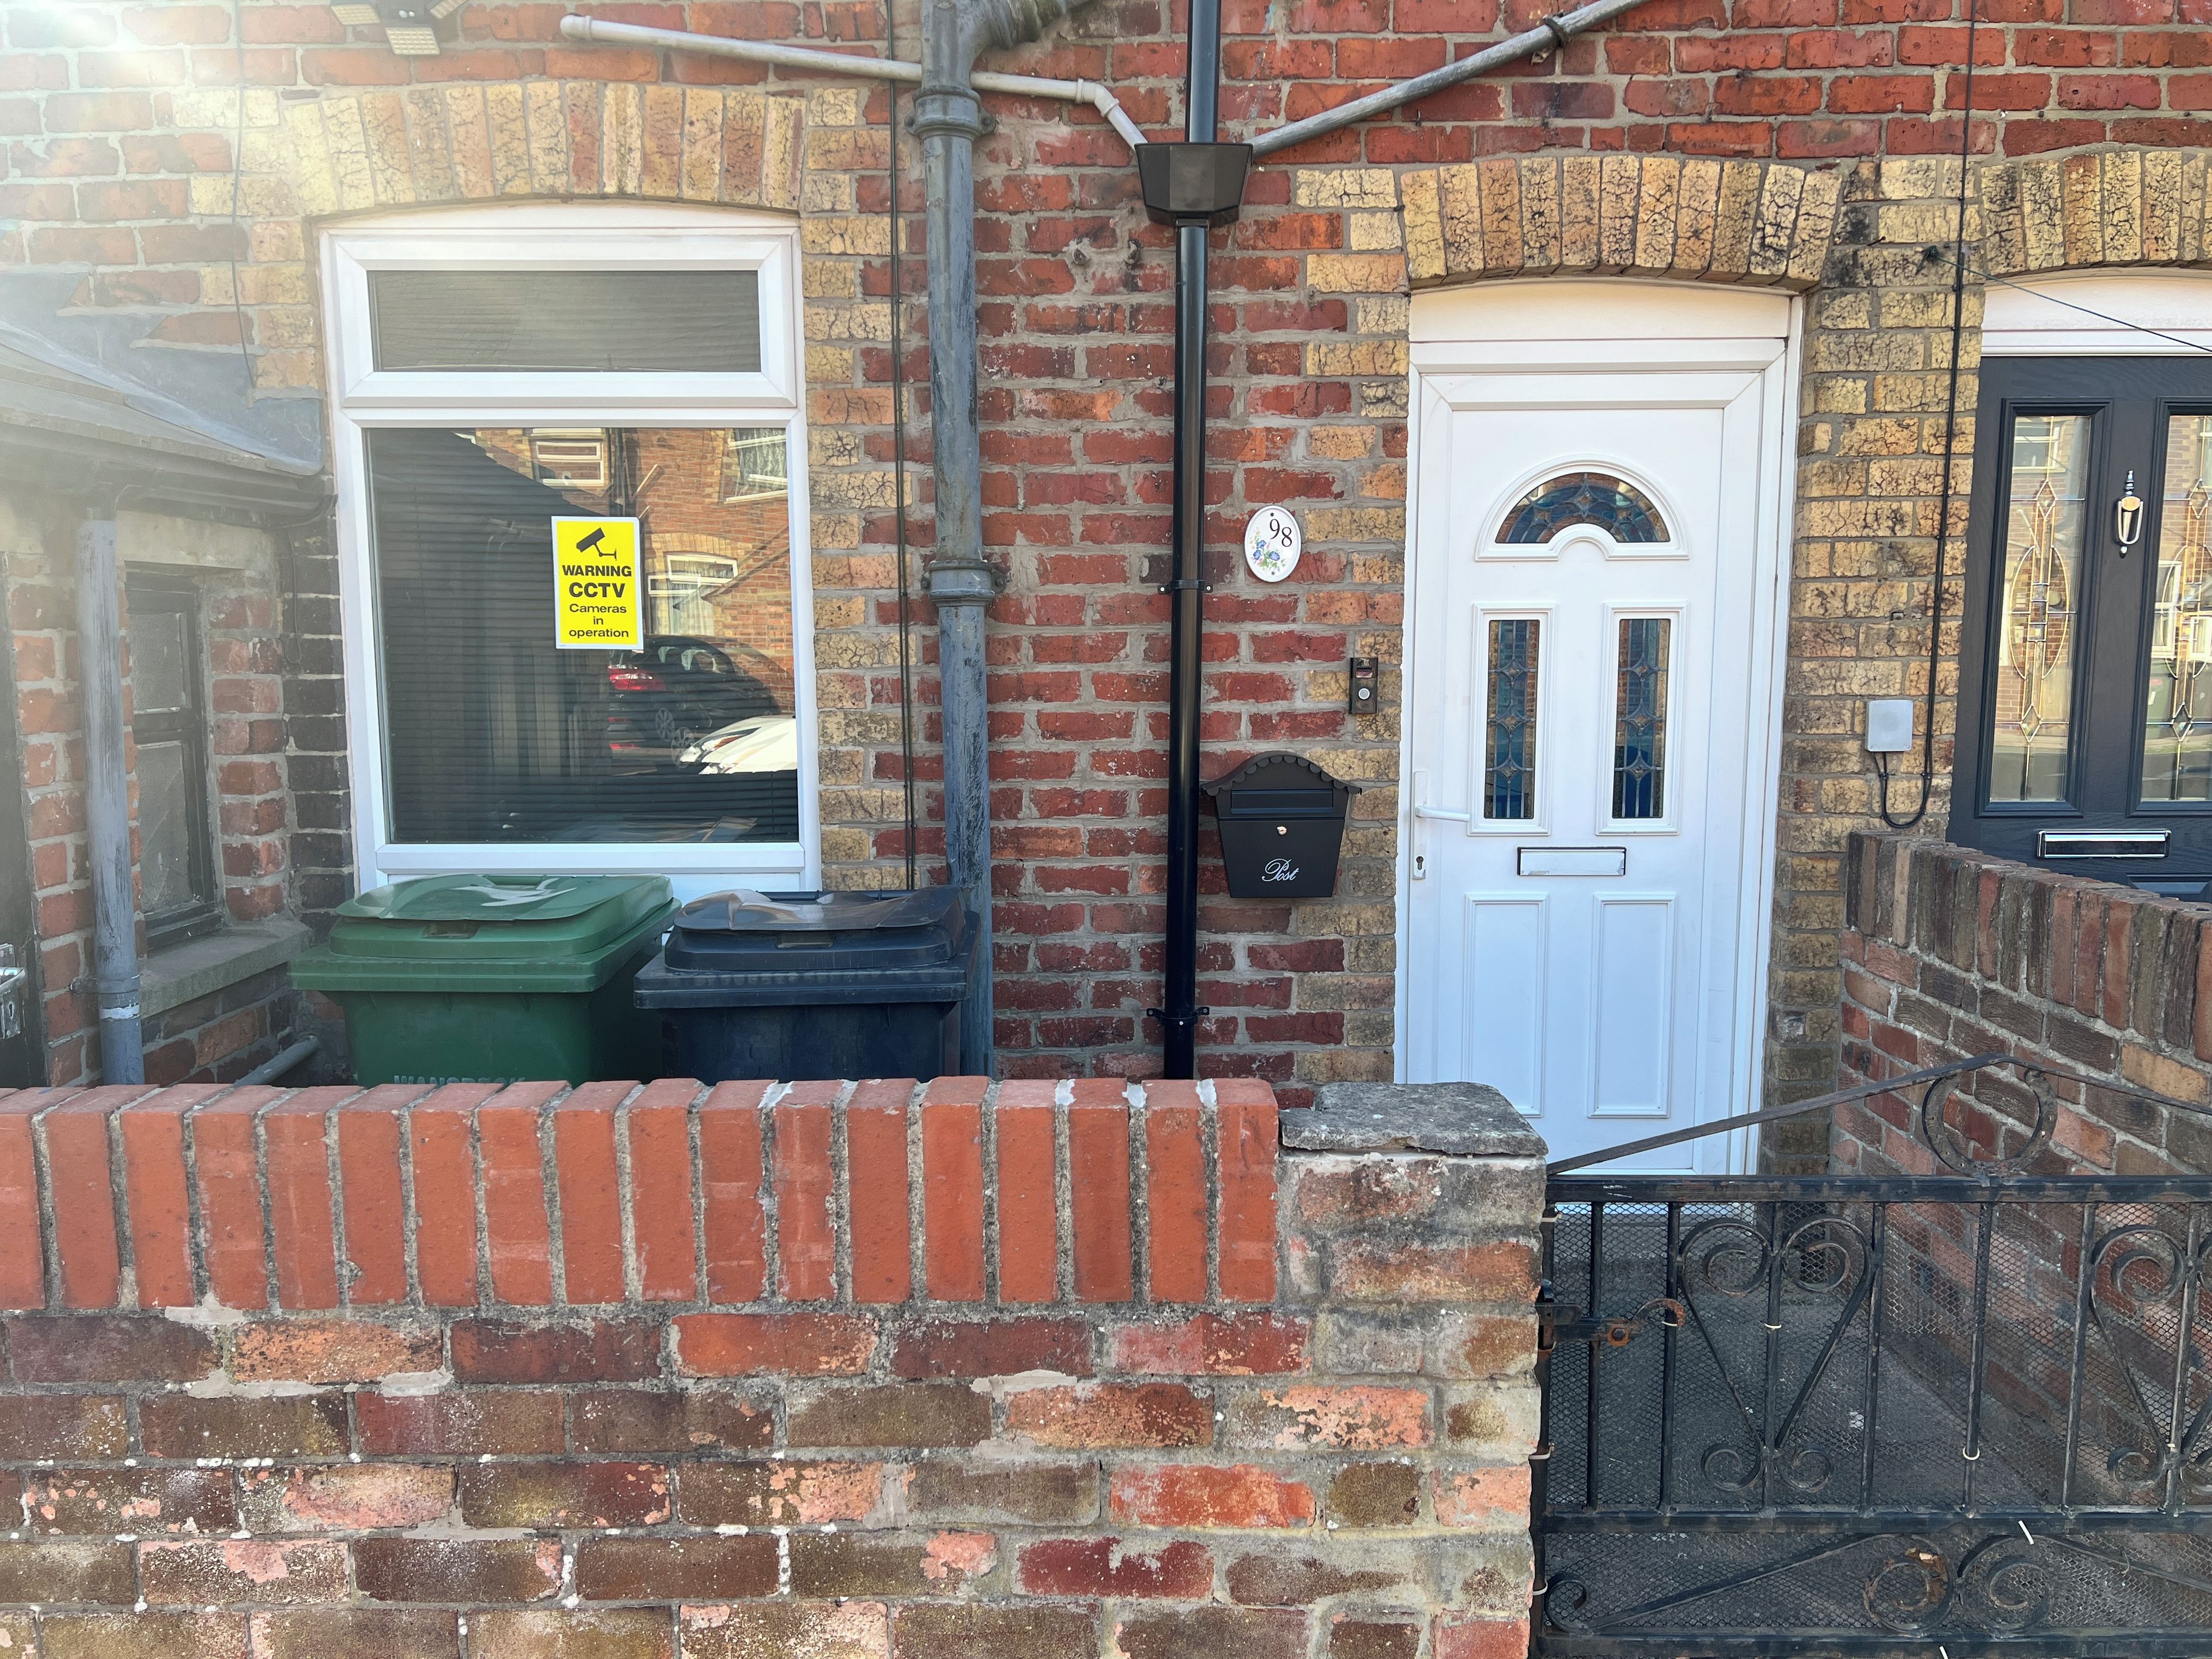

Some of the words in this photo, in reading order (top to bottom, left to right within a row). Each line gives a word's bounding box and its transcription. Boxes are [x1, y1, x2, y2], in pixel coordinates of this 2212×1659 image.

[1270, 518, 1293, 547] 98
[562, 565, 632, 577] WARNING
[569, 582, 626, 598] CCTV
[569, 603, 627, 613] Cameras
[593, 616, 604, 625] in
[569, 628, 629, 639] operation
[1261, 858, 1300, 882] Post
